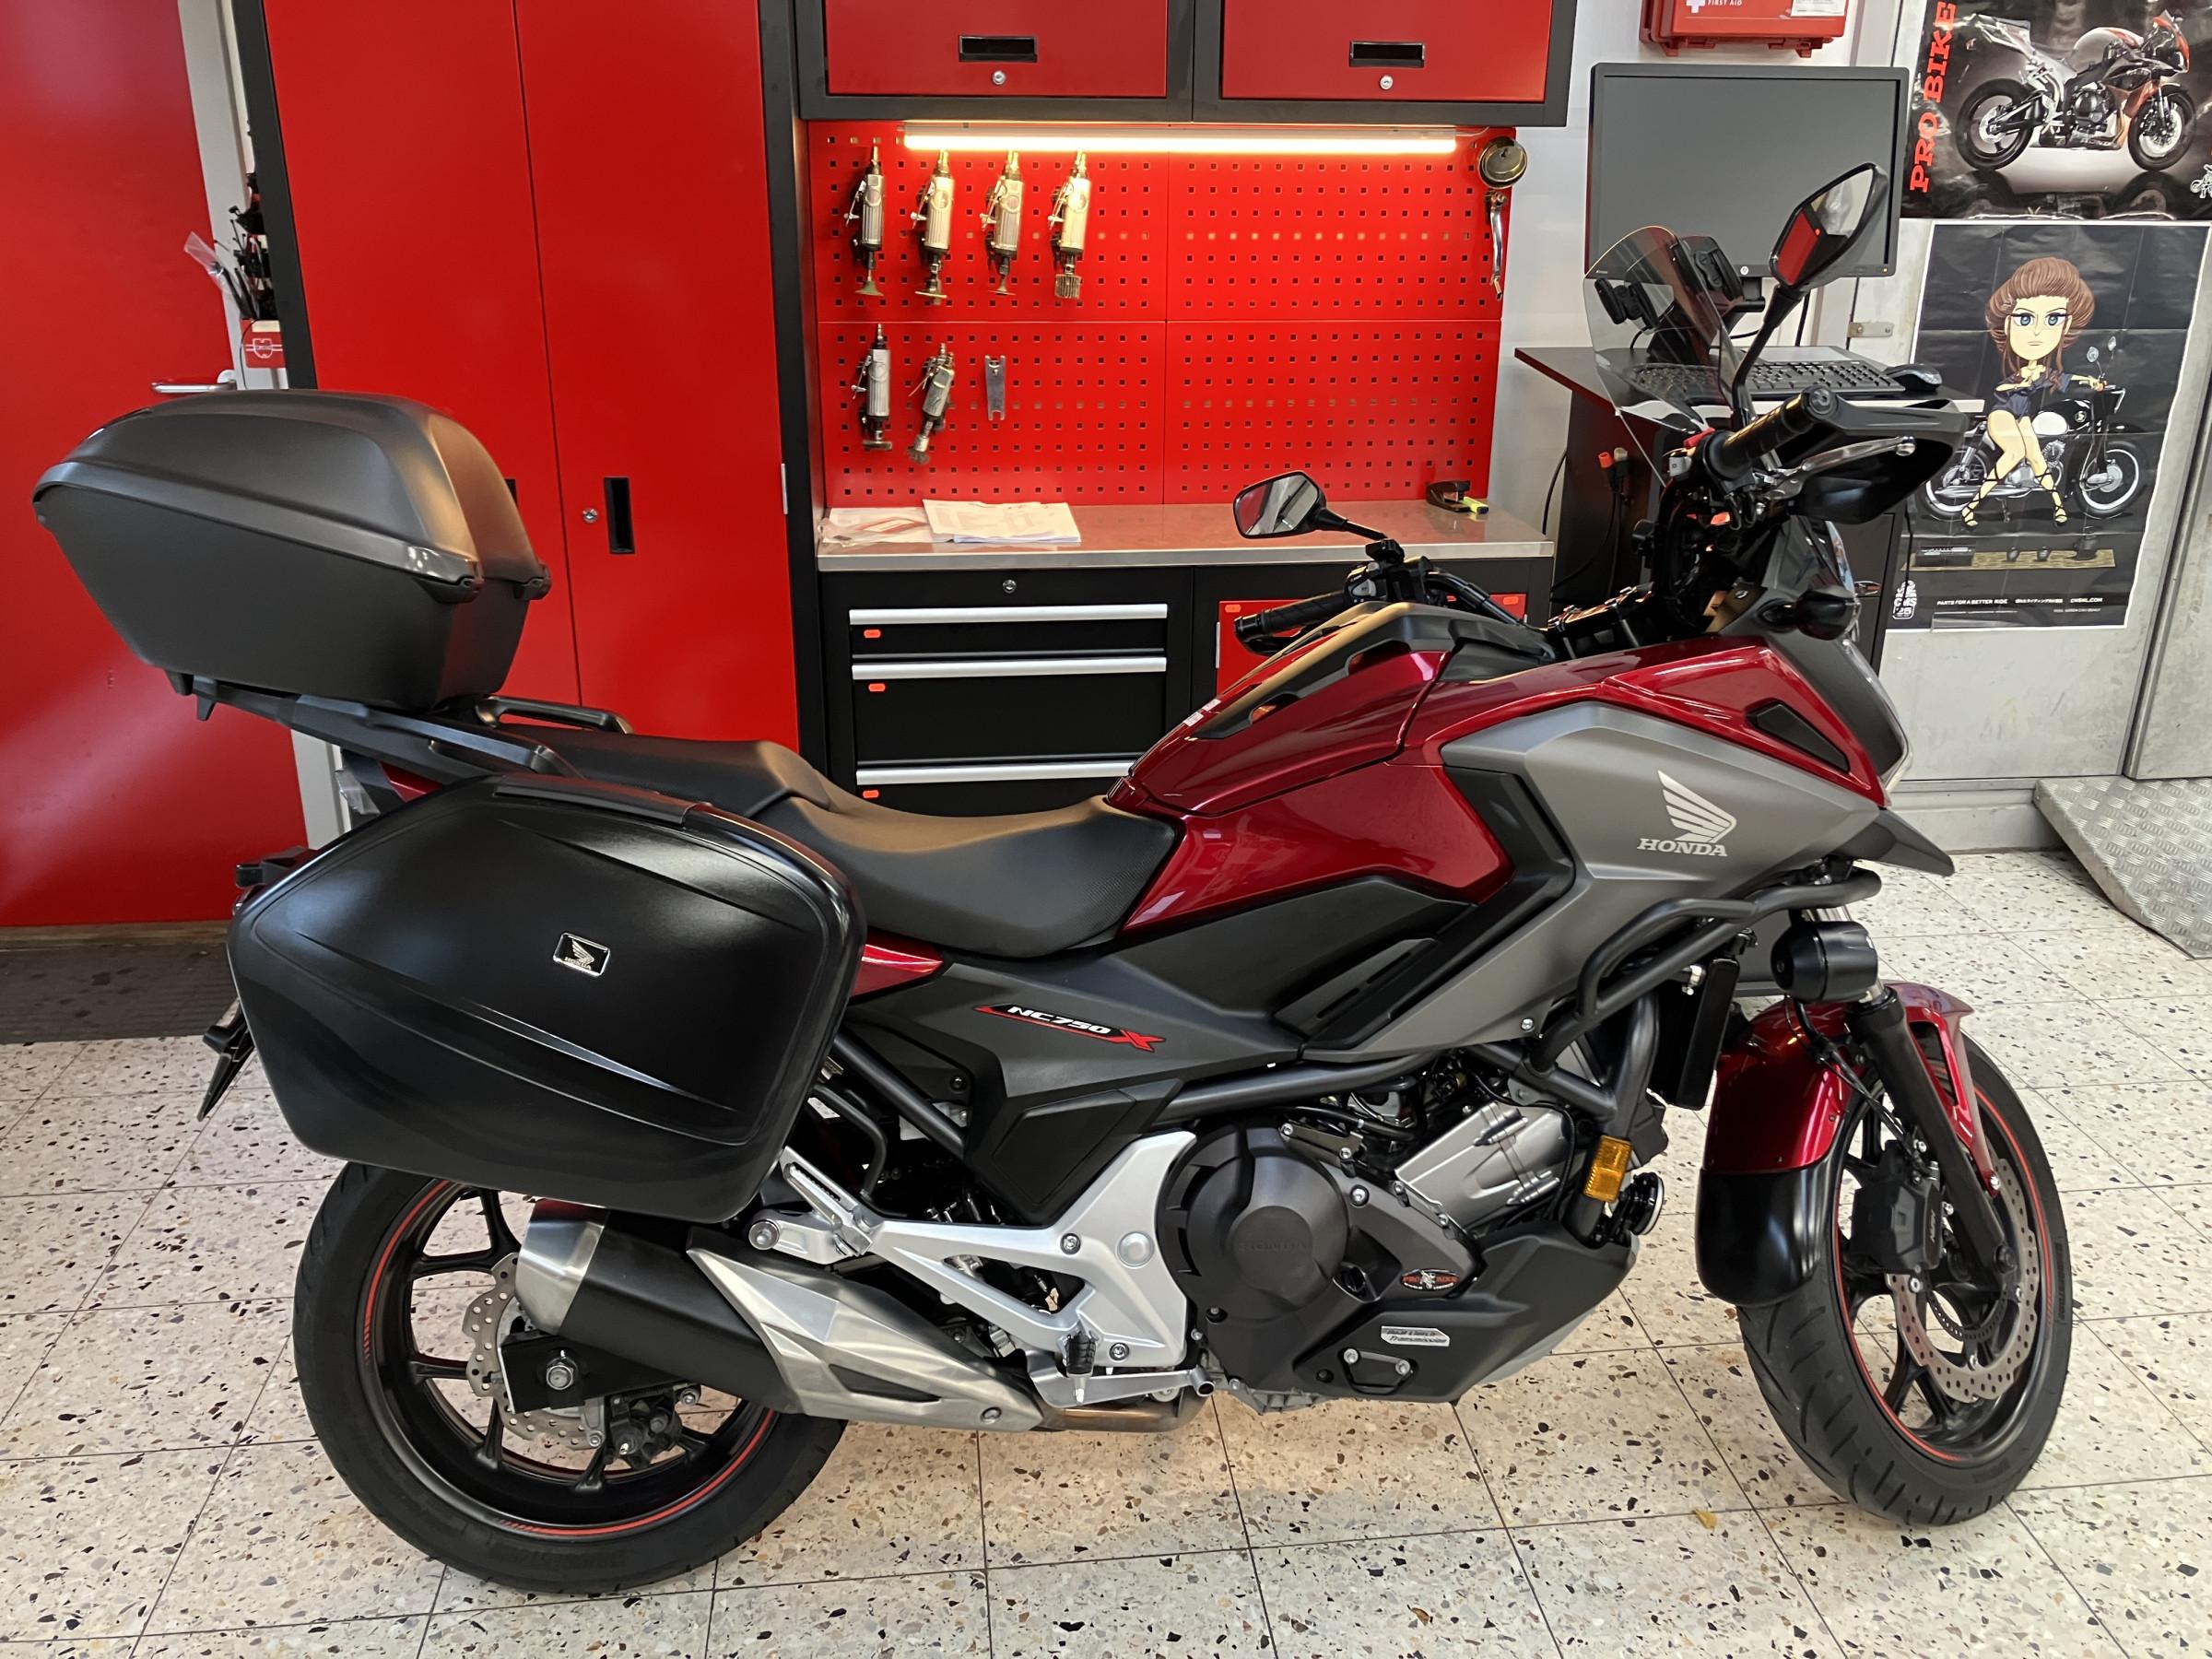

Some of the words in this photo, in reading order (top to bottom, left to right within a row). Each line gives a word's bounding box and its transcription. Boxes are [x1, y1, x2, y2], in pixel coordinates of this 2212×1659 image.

[1923, 2, 1958, 103] BIKE
[1910, 111, 1939, 193] PRO
[1636, 838, 1728, 857] HONDA
[564, 956, 592, 971] HONDA
